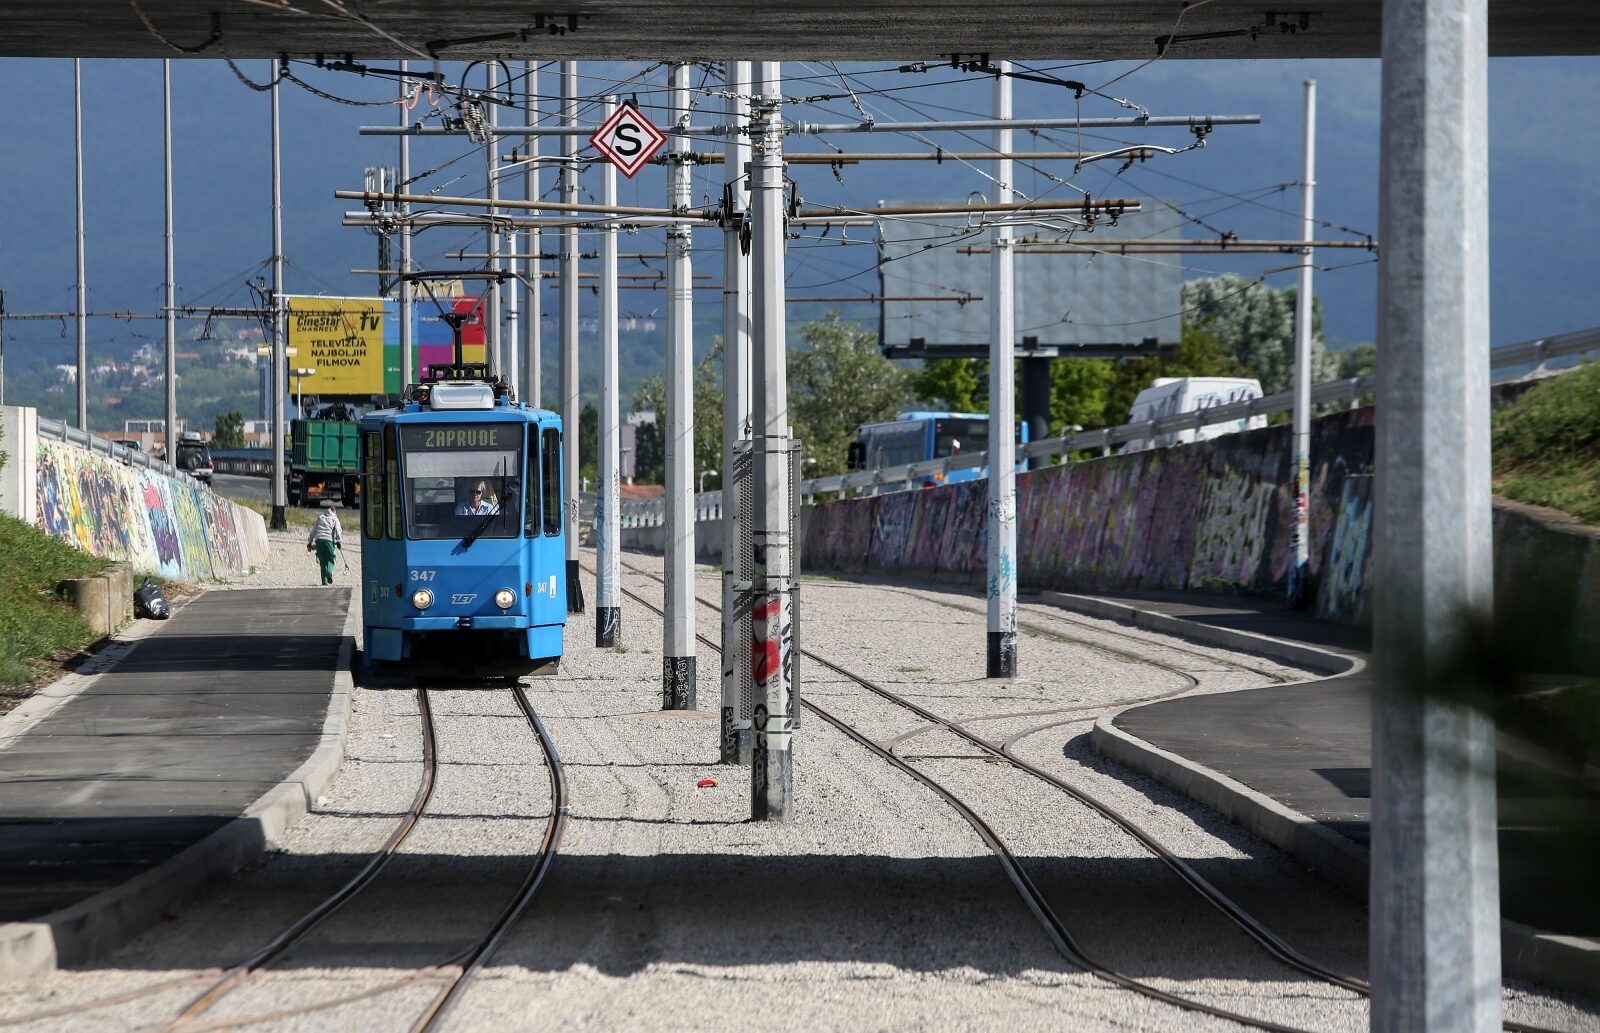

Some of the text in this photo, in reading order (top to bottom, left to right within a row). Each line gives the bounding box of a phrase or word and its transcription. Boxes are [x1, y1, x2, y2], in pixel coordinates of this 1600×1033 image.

[615, 123, 642, 156] S
[311, 339, 366, 348] TELEVIZIJA
[311, 349, 366, 357] NAJBOLJIH
[317, 359, 360, 367] FILMOVA
[410, 570, 436, 582] 347
[537, 582, 547, 593] 347
[452, 593, 477, 605] ZET
